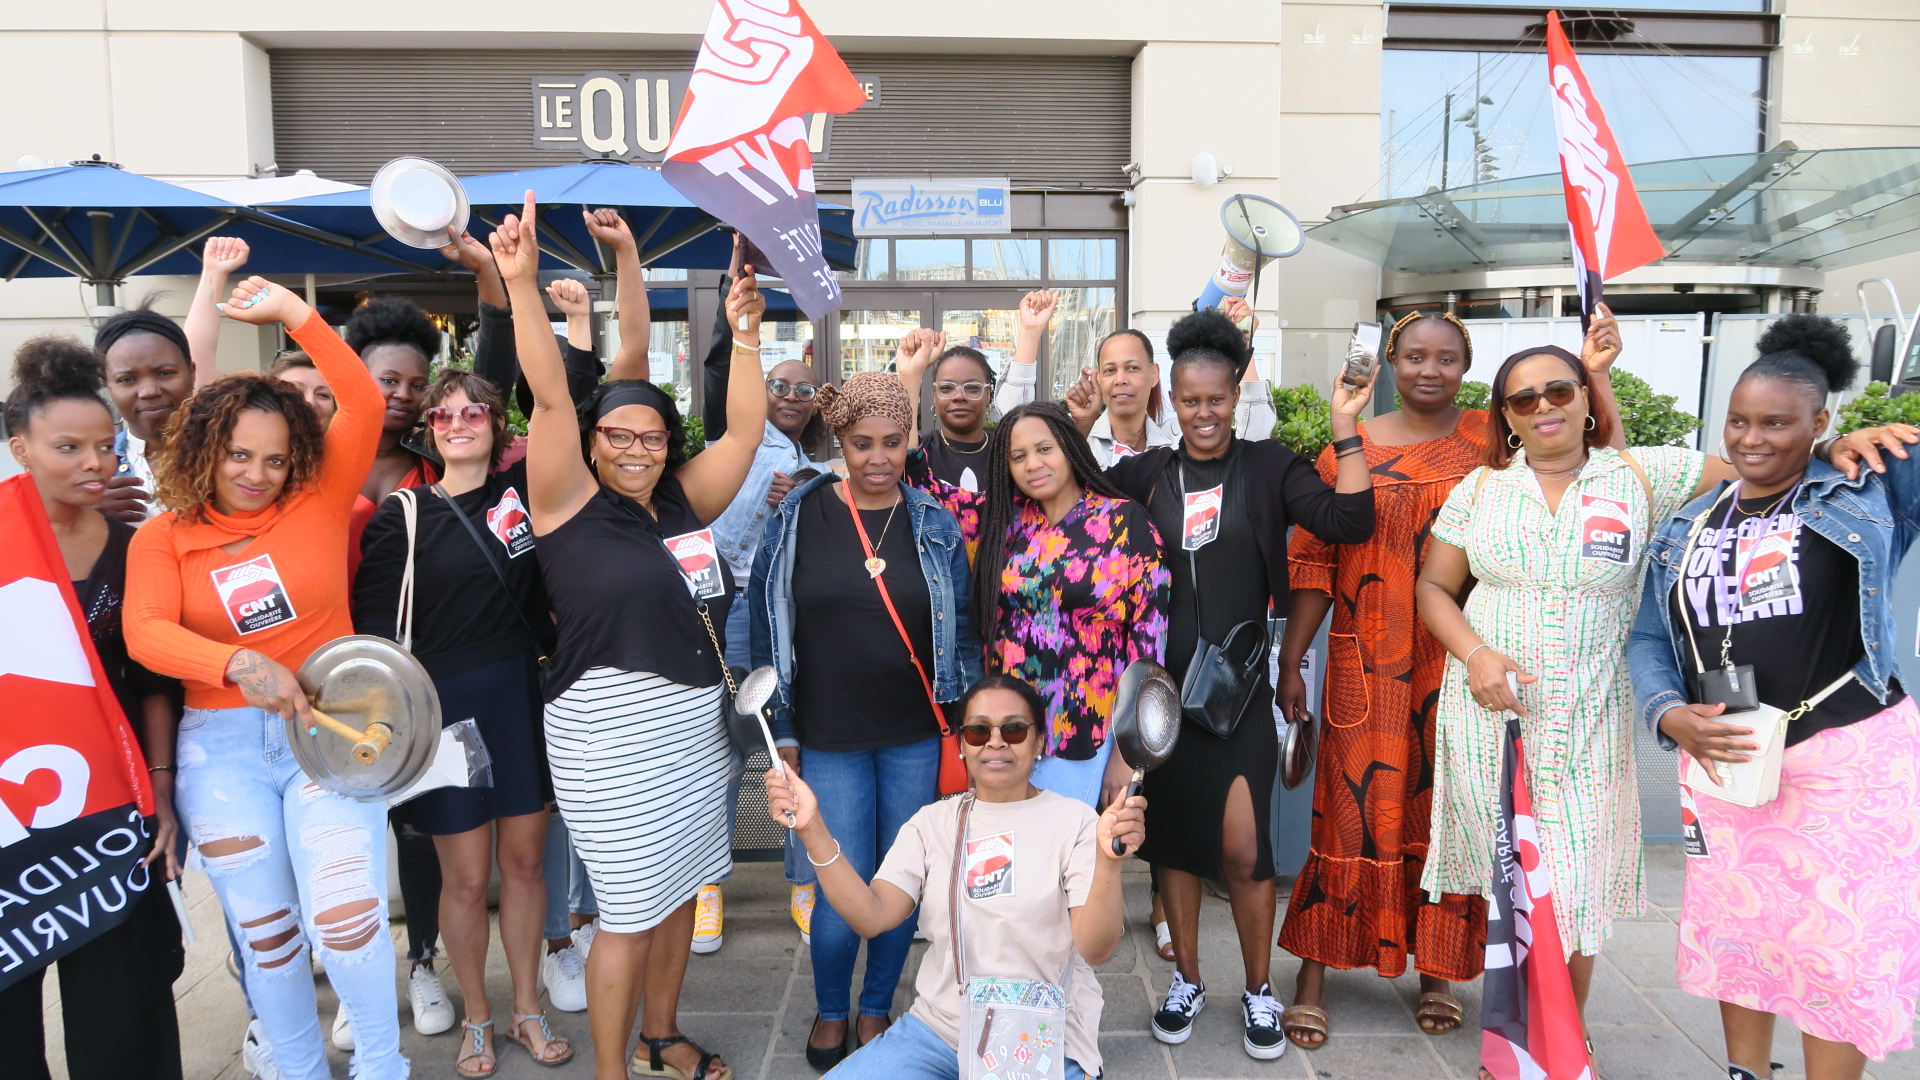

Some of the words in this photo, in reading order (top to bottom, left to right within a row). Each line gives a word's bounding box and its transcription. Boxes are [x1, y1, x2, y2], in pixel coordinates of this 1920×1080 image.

[541, 96, 572, 128] LE
[858, 184, 975, 229] Radisson
[979, 198, 1003, 207] BLU
[928, 219, 962, 228] MARSEILLE
[505, 521, 529, 540] CNT
[1191, 518, 1214, 536] CNT
[1590, 529, 1625, 546] CNT
[1590, 544, 1624, 555] SOLIDARITÉ
[1592, 550, 1622, 560] OUVRIÈRE
[1687, 541, 1733, 578] OF
[687, 568, 711, 582] NT
[1745, 565, 1781, 588] CNT
[697, 581, 714, 590] ARITÉ
[1748, 581, 1784, 598] SOLIDARITÉ
[1751, 589, 1784, 603] OUVRIÈRE
[239, 594, 276, 617] CNT
[244, 607, 282, 626] SOLIDARITÉ
[249, 614, 282, 629] OUVRIÈRE
[974, 868, 1005, 887] CNT
